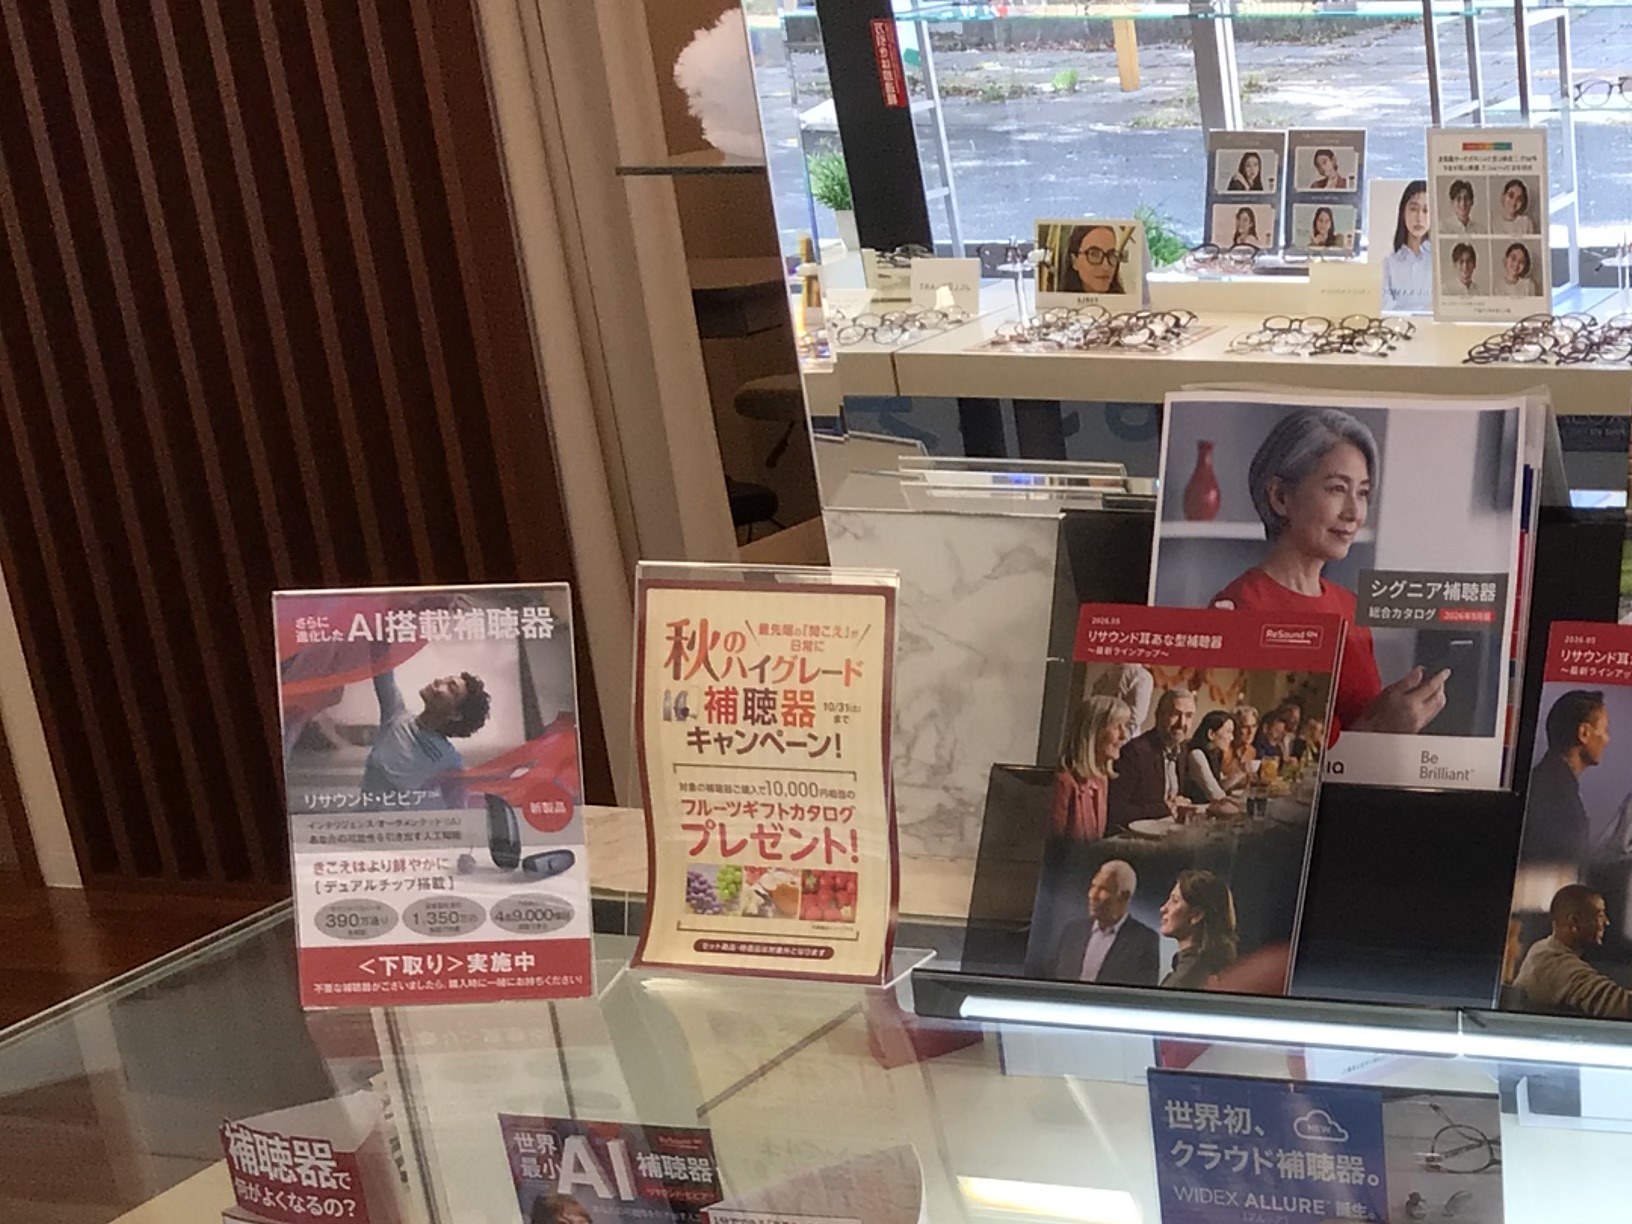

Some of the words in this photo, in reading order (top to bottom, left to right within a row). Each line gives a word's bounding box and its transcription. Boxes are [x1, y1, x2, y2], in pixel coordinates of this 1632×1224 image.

[1371, 580, 1497, 602] シグニア補聴器
[296, 616, 329, 629] さらに
[1369, 606, 1436, 620] 総合カタログ
[348, 606, 554, 643] AI搭載補聴器
[1266, 629, 1304, 639] ReSound
[296, 629, 344, 643] 進化した
[1088, 630, 1222, 649] リサウンド耳あな型補聴器
[722, 655, 864, 687] ハイグレード
[704, 685, 816, 728] 補聴器
[833, 715, 849, 725] まで
[687, 726, 841, 758] キャンペーン!
[1421, 751, 1438, 764] Be
[530, 802, 567, 814] 新製品
[682, 800, 856, 824] フルーツギフトカタログ
[681, 819, 859, 864] プレゼント!
[313, 857, 449, 875] きこえはより鮮やかに
[1165, 1099, 1265, 1137] 世界初、
[514, 1133, 557, 1155] 世界
[225, 1123, 351, 1190] 補聴器で
[521, 1156, 560, 1179] 最小
[557, 1135, 635, 1200] AI
[636, 1152, 713, 1183] 補聴器
[1170, 1140, 1379, 1187] クラウド補聴器。
[1172, 1185, 1239, 1206] WIDEX
